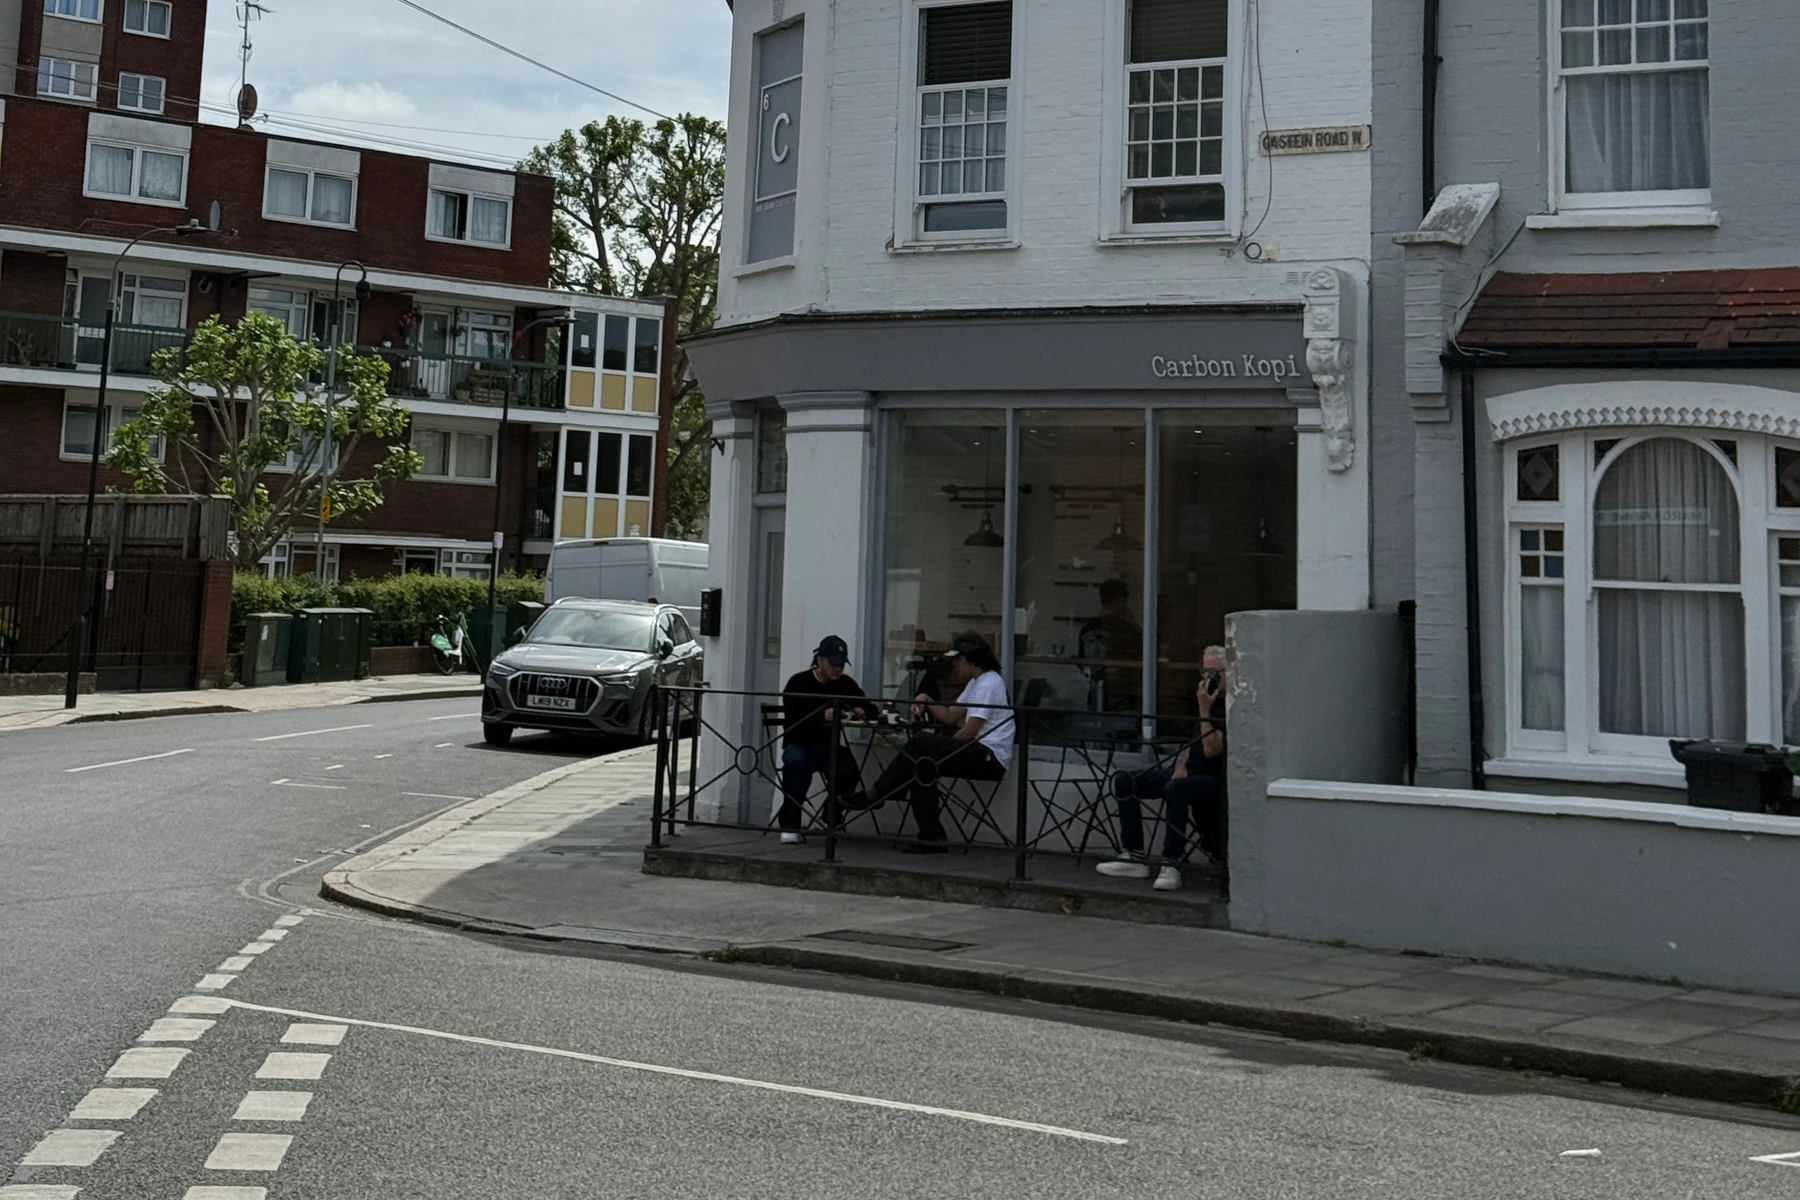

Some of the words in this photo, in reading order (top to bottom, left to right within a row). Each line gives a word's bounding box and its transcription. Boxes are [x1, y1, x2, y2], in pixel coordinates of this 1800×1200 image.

[763, 93, 769, 111] 6
[771, 112, 791, 163] C
[1262, 133, 1313, 151] GASTEIN
[1315, 131, 1349, 148] ROAD
[1151, 354, 1236, 378] Carbon
[1242, 354, 1301, 383] Kopi
